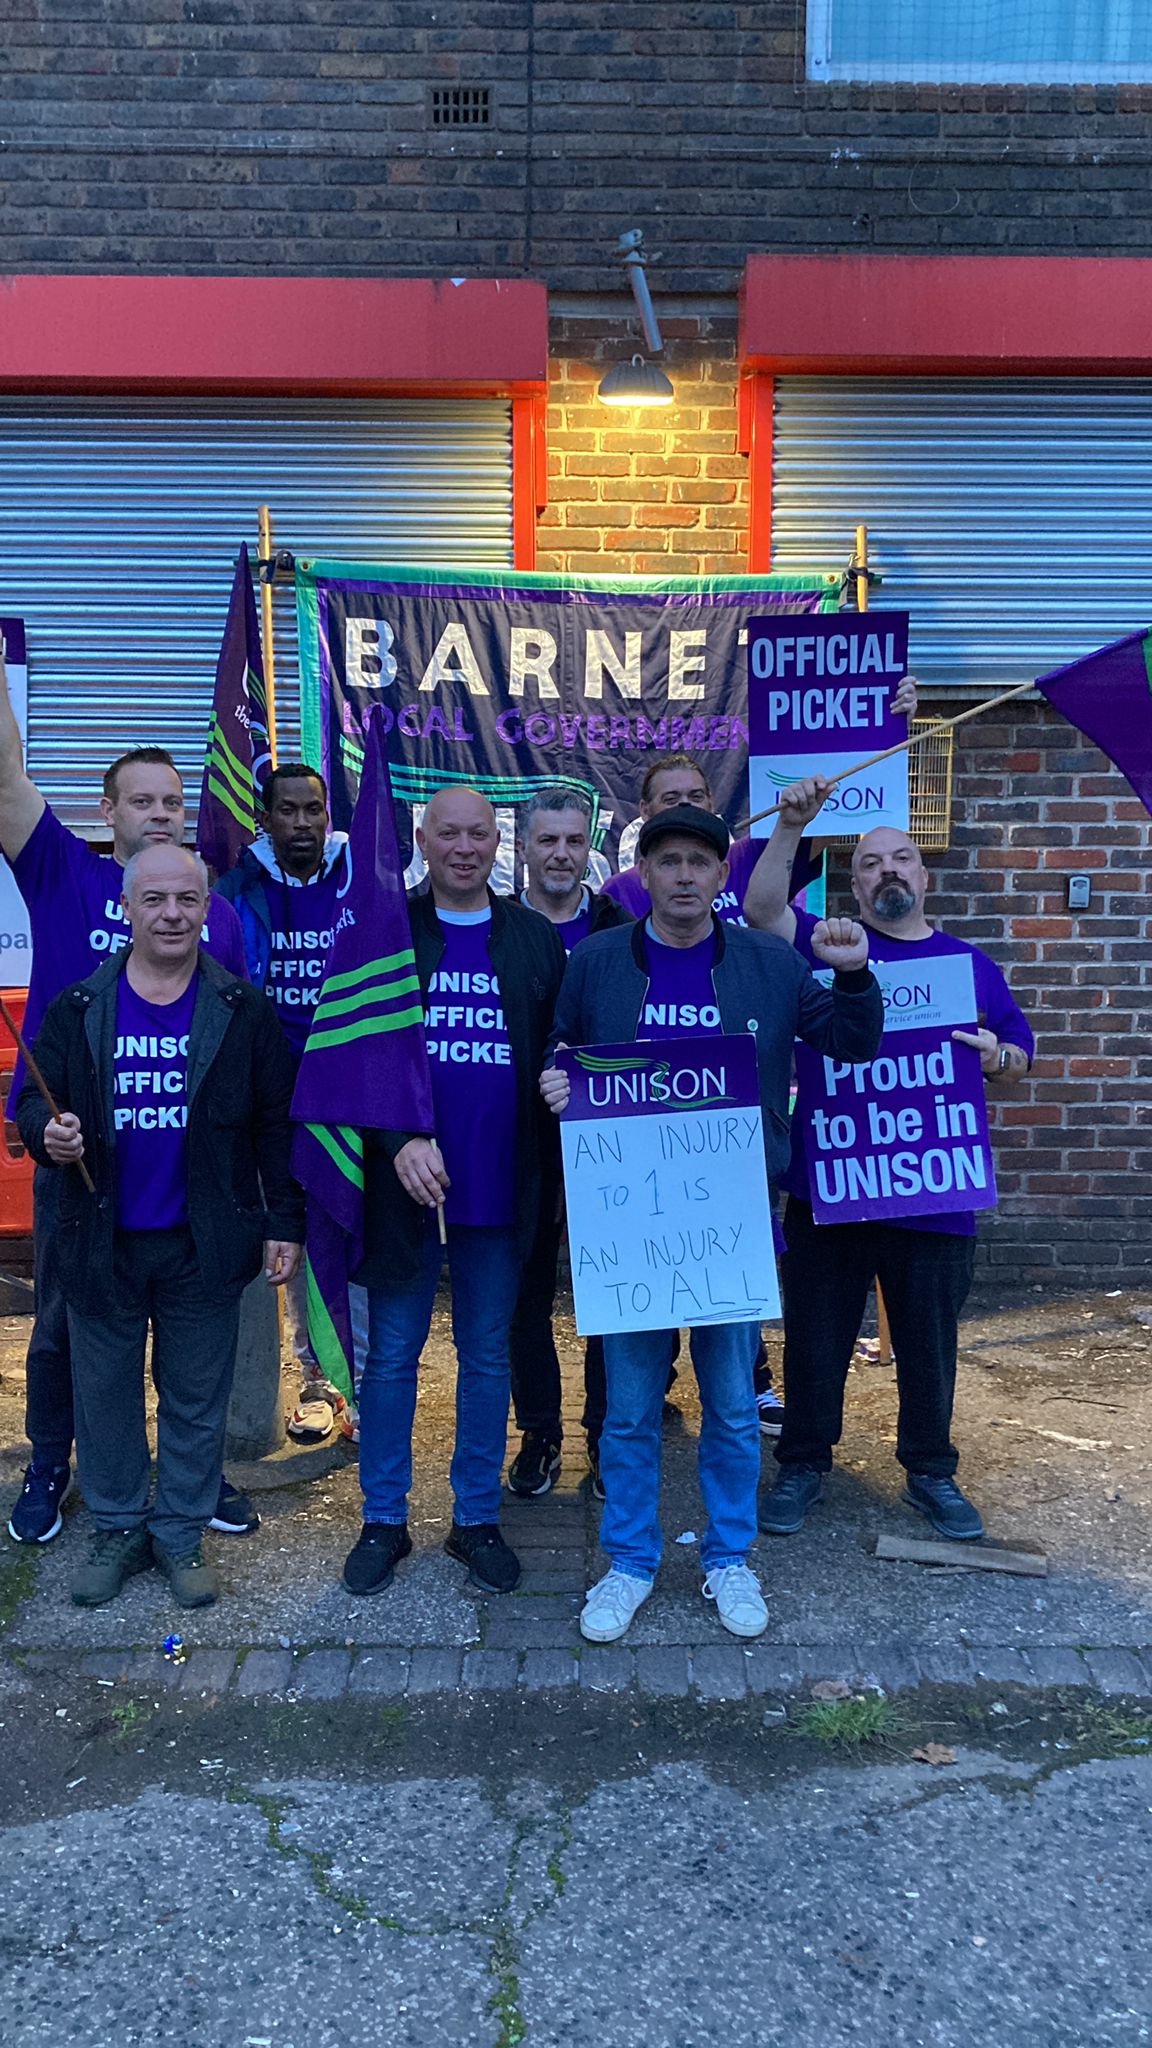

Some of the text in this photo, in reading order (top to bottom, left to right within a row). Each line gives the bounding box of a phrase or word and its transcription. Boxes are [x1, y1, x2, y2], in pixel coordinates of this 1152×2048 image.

[344, 617, 748, 700] BARNE
[751, 633, 904, 679] OFFICIAL
[343, 700, 749, 751] LOCAL GOVERNMEN
[768, 686, 890, 731] PICKET
[271, 930, 332, 950] NISO
[265, 985, 320, 1006] PICK
[639, 1003, 722, 1028] NISO
[426, 1040, 513, 1065] PICKE
[823, 1041, 955, 1096] Proud
[114, 1071, 187, 1094] FFIC
[588, 1066, 727, 1107] UNISON
[574, 1116, 760, 1169] AN INJURY
[811, 1094, 977, 1150] to be in
[597, 1169, 711, 1216] TO 1 IS
[815, 1145, 987, 1204] UNISON
[578, 1223, 743, 1277] AN INJURY
[604, 1267, 769, 1317] TO ALL
